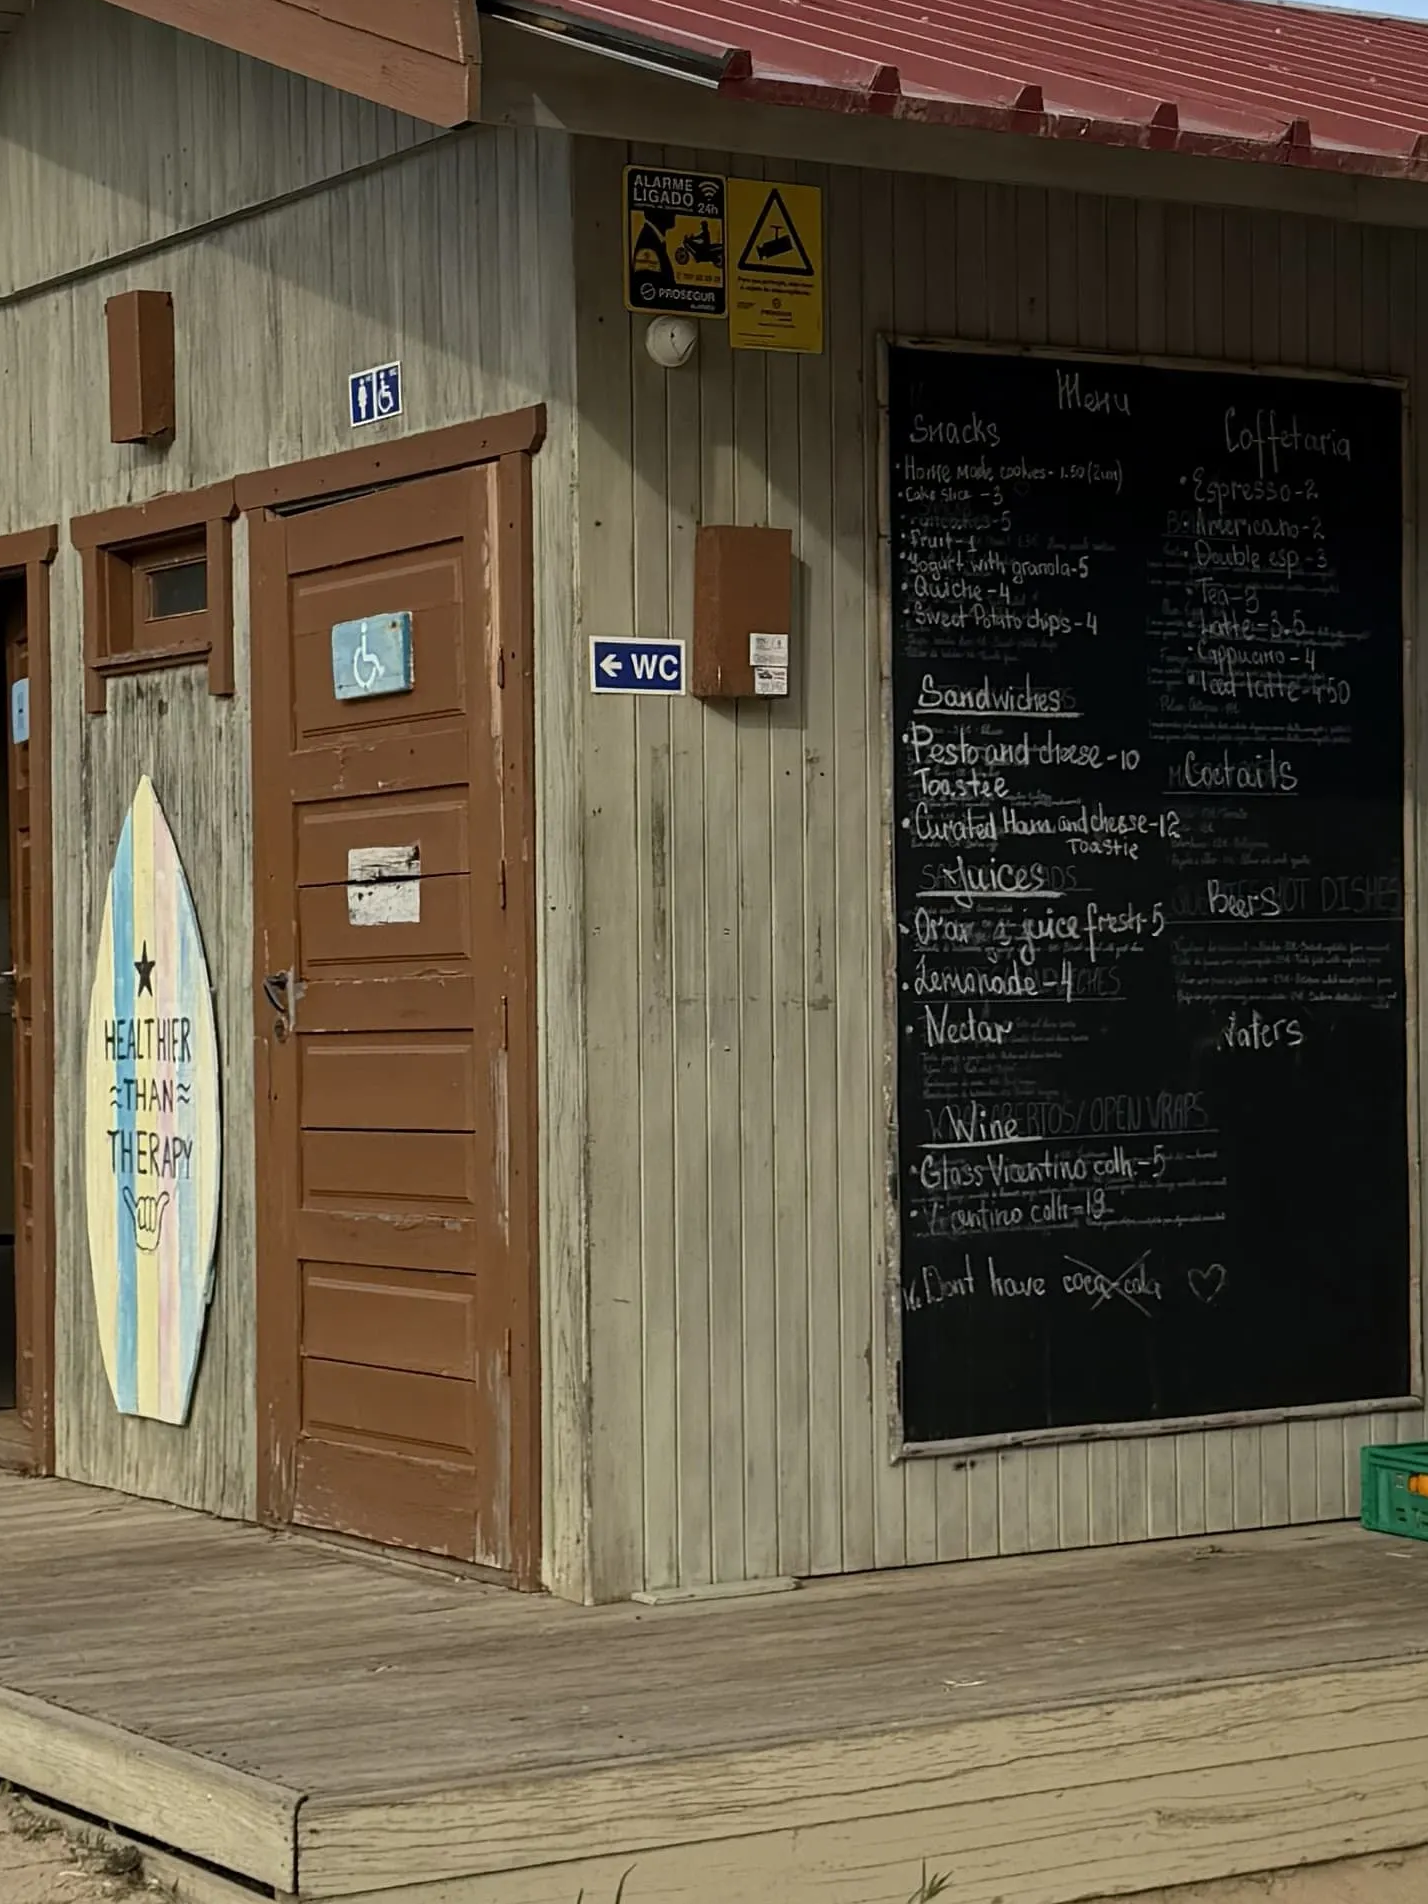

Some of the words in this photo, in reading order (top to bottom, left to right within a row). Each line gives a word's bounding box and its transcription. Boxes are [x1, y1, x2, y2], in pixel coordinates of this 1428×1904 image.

[633, 187, 694, 207] LIGADO
[634, 174, 693, 192] ALARME
[658, 287, 716, 302] PROSEGUR
[1056, 368, 1131, 416] Menu
[910, 411, 1000, 447] Snacks
[972, 550, 1005, 576] with
[1194, 539, 1261, 568] Double
[973, 603, 1021, 629] Potato
[630, 652, 680, 682] WC
[918, 672, 1060, 712] Sandwiches
[910, 721, 978, 765] Pesto
[984, 731, 1029, 766] and
[1058, 804, 1088, 835] and
[1066, 838, 1139, 860] Toastie
[941, 854, 1045, 908] Juices
[1206, 878, 1282, 919] Beers
[104, 1017, 192, 1063] HEALTHIER
[925, 1003, 1013, 1047] Nectar
[122, 1078, 174, 1113] THAN
[945, 1099, 1019, 1141] Wine
[106, 1129, 193, 1180] THERAPY
[920, 1153, 983, 1191] Glass
[988, 1256, 1046, 1297] have
